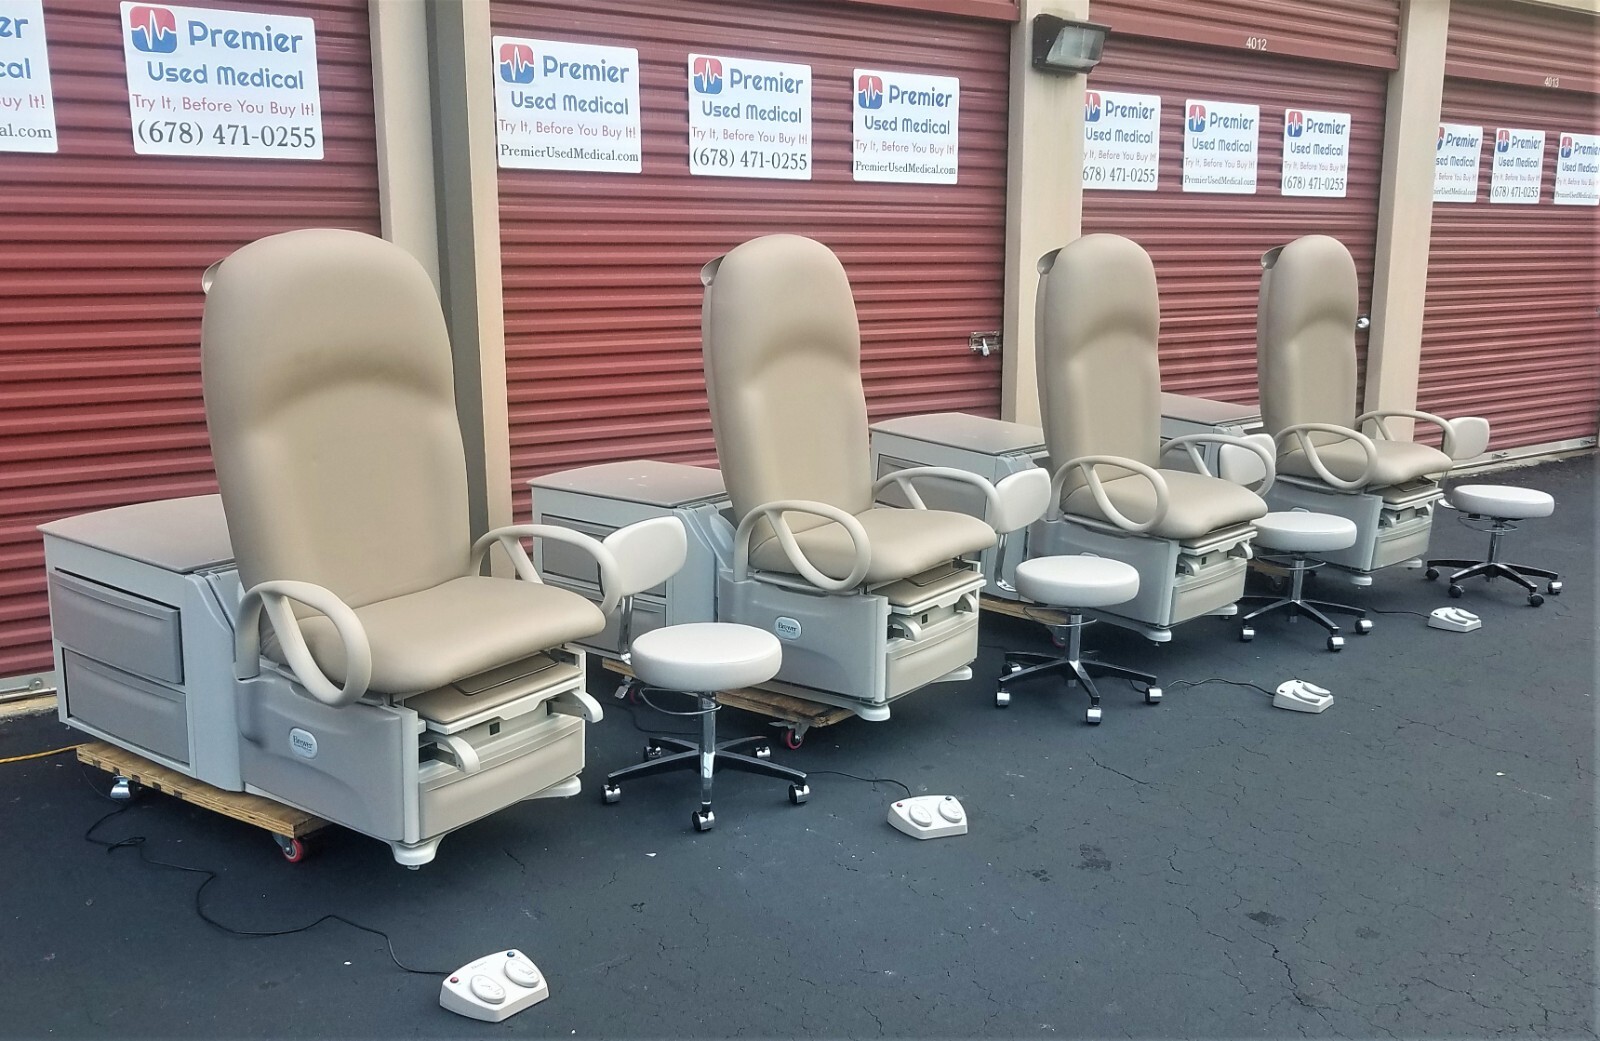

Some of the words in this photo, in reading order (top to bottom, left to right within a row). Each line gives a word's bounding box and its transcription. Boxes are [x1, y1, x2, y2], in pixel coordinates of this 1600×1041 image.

[188, 20, 302, 53] Premier
[1246, 37, 1267, 50] 4012
[147, 61, 207, 84] Used
[217, 66, 304, 89] Medical
[543, 55, 629, 83] Premier
[730, 68, 804, 94] Premier
[1544, 77, 1560, 88] 4013
[0, 97, 22, 111] uy
[29, 94, 45, 109] It!
[511, 91, 556, 110] Used
[563, 94, 628, 115] Medical
[889, 84, 952, 108] Premier
[132, 94, 155, 111] Try
[161, 96, 176, 112] It,
[182, 97, 232, 113] Before
[237, 100, 264, 115] You
[270, 102, 296, 118] Buy
[301, 103, 315, 116] It!
[702, 101, 740, 119] Used
[746, 104, 802, 123] Medical
[1106, 100, 1155, 120] Premier
[499, 119, 516, 133] Try
[520, 120, 531, 134] It,
[536, 122, 574, 135] Before
[578, 124, 598, 136] You
[602, 125, 622, 139] Buy
[625, 126, 636, 138] It!
[865, 115, 898, 131] Used
[902, 118, 950, 134] Medical
[1210, 112, 1254, 130] Premier
[1306, 118, 1346, 135] Premier
[138, 120, 203, 145] (678)
[213, 125, 316, 148] 471-0255
[691, 126, 706, 140] Try
[709, 128, 719, 140] It,
[723, 129, 754, 142] Before
[758, 132, 775, 143] You
[778, 133, 796, 147] Buy
[1086, 128, 1112, 141] Used
[1114, 129, 1153, 144] Medical
[1446, 133, 1478, 148] Premier
[856, 140, 867, 152] Try
[882, 140, 909, 152] Before
[912, 142, 926, 154] You
[930, 144, 944, 156] Buy
[1192, 137, 1216, 150] Used
[1218, 139, 1252, 152] Medical
[1290, 142, 1310, 154] Used
[1313, 144, 1344, 156] Medical
[1512, 136, 1542, 150] Premier
[500, 144, 639, 162] PremierUsedMedical.com
[693, 147, 735, 168] (678)
[740, 150, 807, 171] 471-0255
[1098, 150, 1120, 160] Before
[1123, 152, 1134, 160] You
[1136, 152, 1148, 163] Buy
[1450, 156, 1476, 167] Medical
[855, 160, 956, 174] PremierUsedMedical.com
[1186, 158, 1194, 168] Try
[1204, 158, 1222, 168] Before
[1224, 160, 1235, 168] You
[1237, 160, 1248, 170] Buy
[1300, 162, 1317, 170] Before
[1319, 163, 1328, 171] You
[1330, 164, 1339, 173] Buy
[1498, 157, 1514, 166] Used
[1516, 158, 1539, 168] Medical
[1110, 167, 1156, 182] 471-0255
[1284, 176, 1306, 190] (678)
[1308, 177, 1344, 190] 471-0255
[1492, 186, 1509, 198] (678)
[1511, 186, 1538, 198] 471-0255
